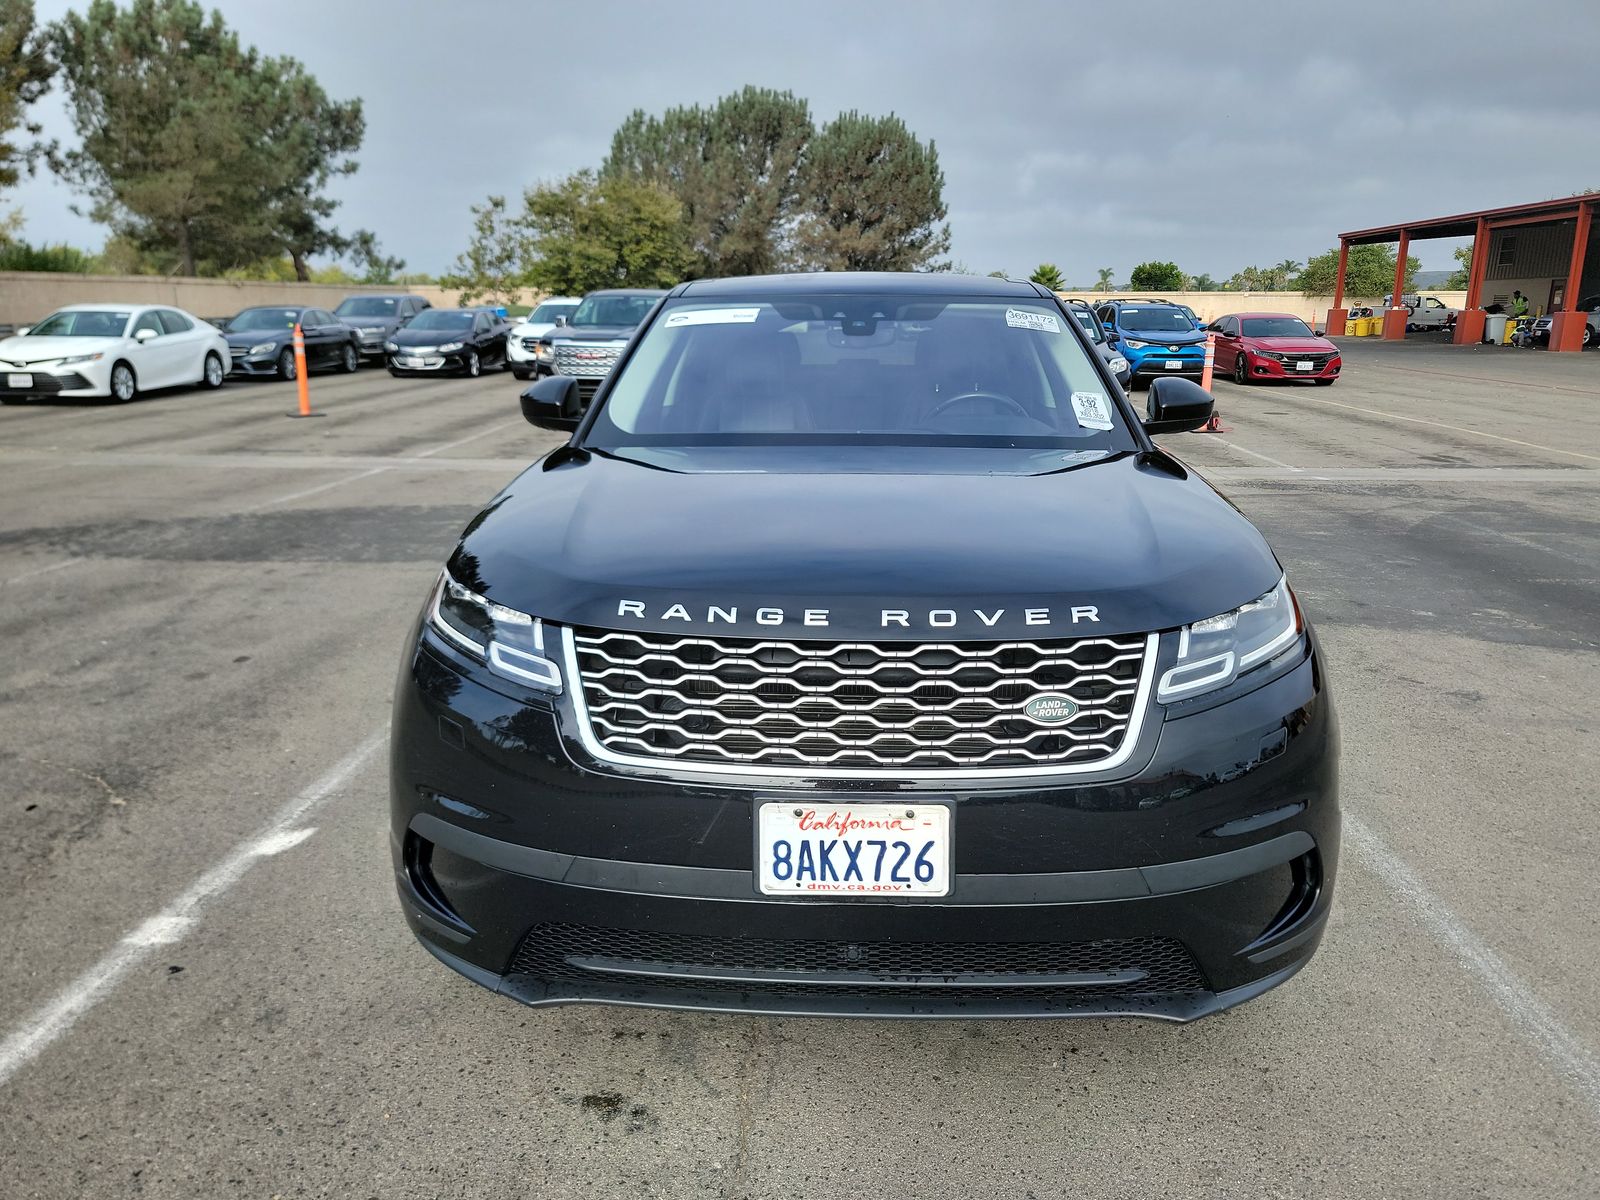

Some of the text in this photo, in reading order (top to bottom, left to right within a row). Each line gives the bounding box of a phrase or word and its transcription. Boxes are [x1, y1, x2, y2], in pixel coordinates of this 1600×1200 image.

[1008, 310, 1054, 323] 3691172
[618, 599, 1100, 627] RANGE ROVER
[1036, 700, 1061, 709] LAND
[1039, 708, 1070, 717] ROVER
[799, 811, 914, 836] California
[772, 839, 936, 883] 8AKX726
[807, 882, 902, 892] dmv.ca.gov
